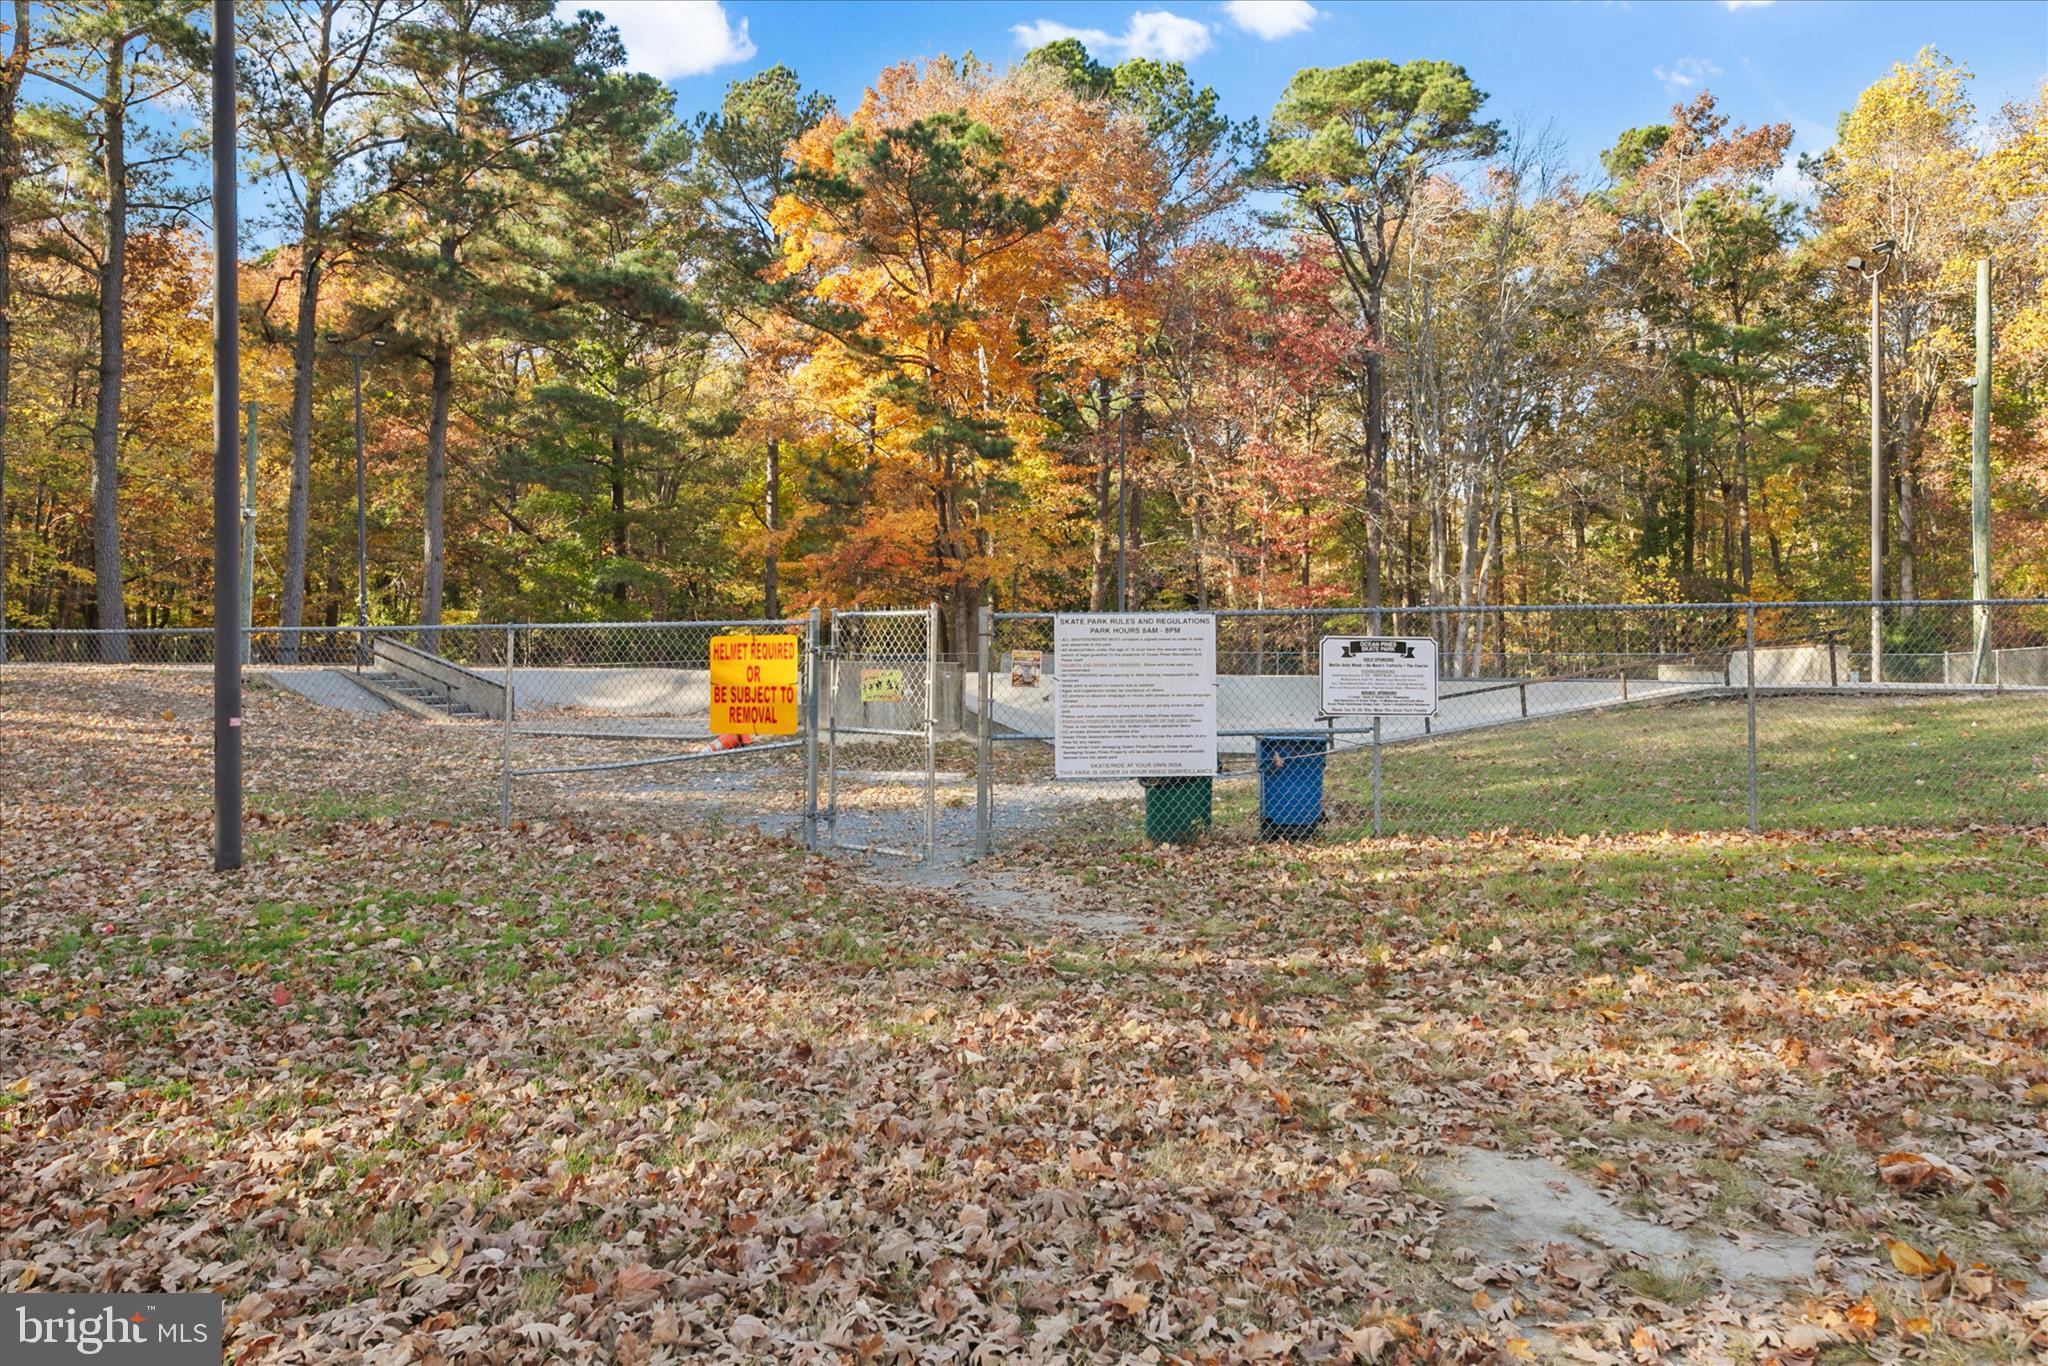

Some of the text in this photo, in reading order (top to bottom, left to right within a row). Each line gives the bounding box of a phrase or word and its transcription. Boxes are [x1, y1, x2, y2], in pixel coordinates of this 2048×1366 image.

[713, 642, 795, 660] HELMET REQUIRED
[746, 665, 761, 683] OR
[714, 686, 795, 704] BE SUBJECT TO
[729, 706, 778, 724] REMOVAL
